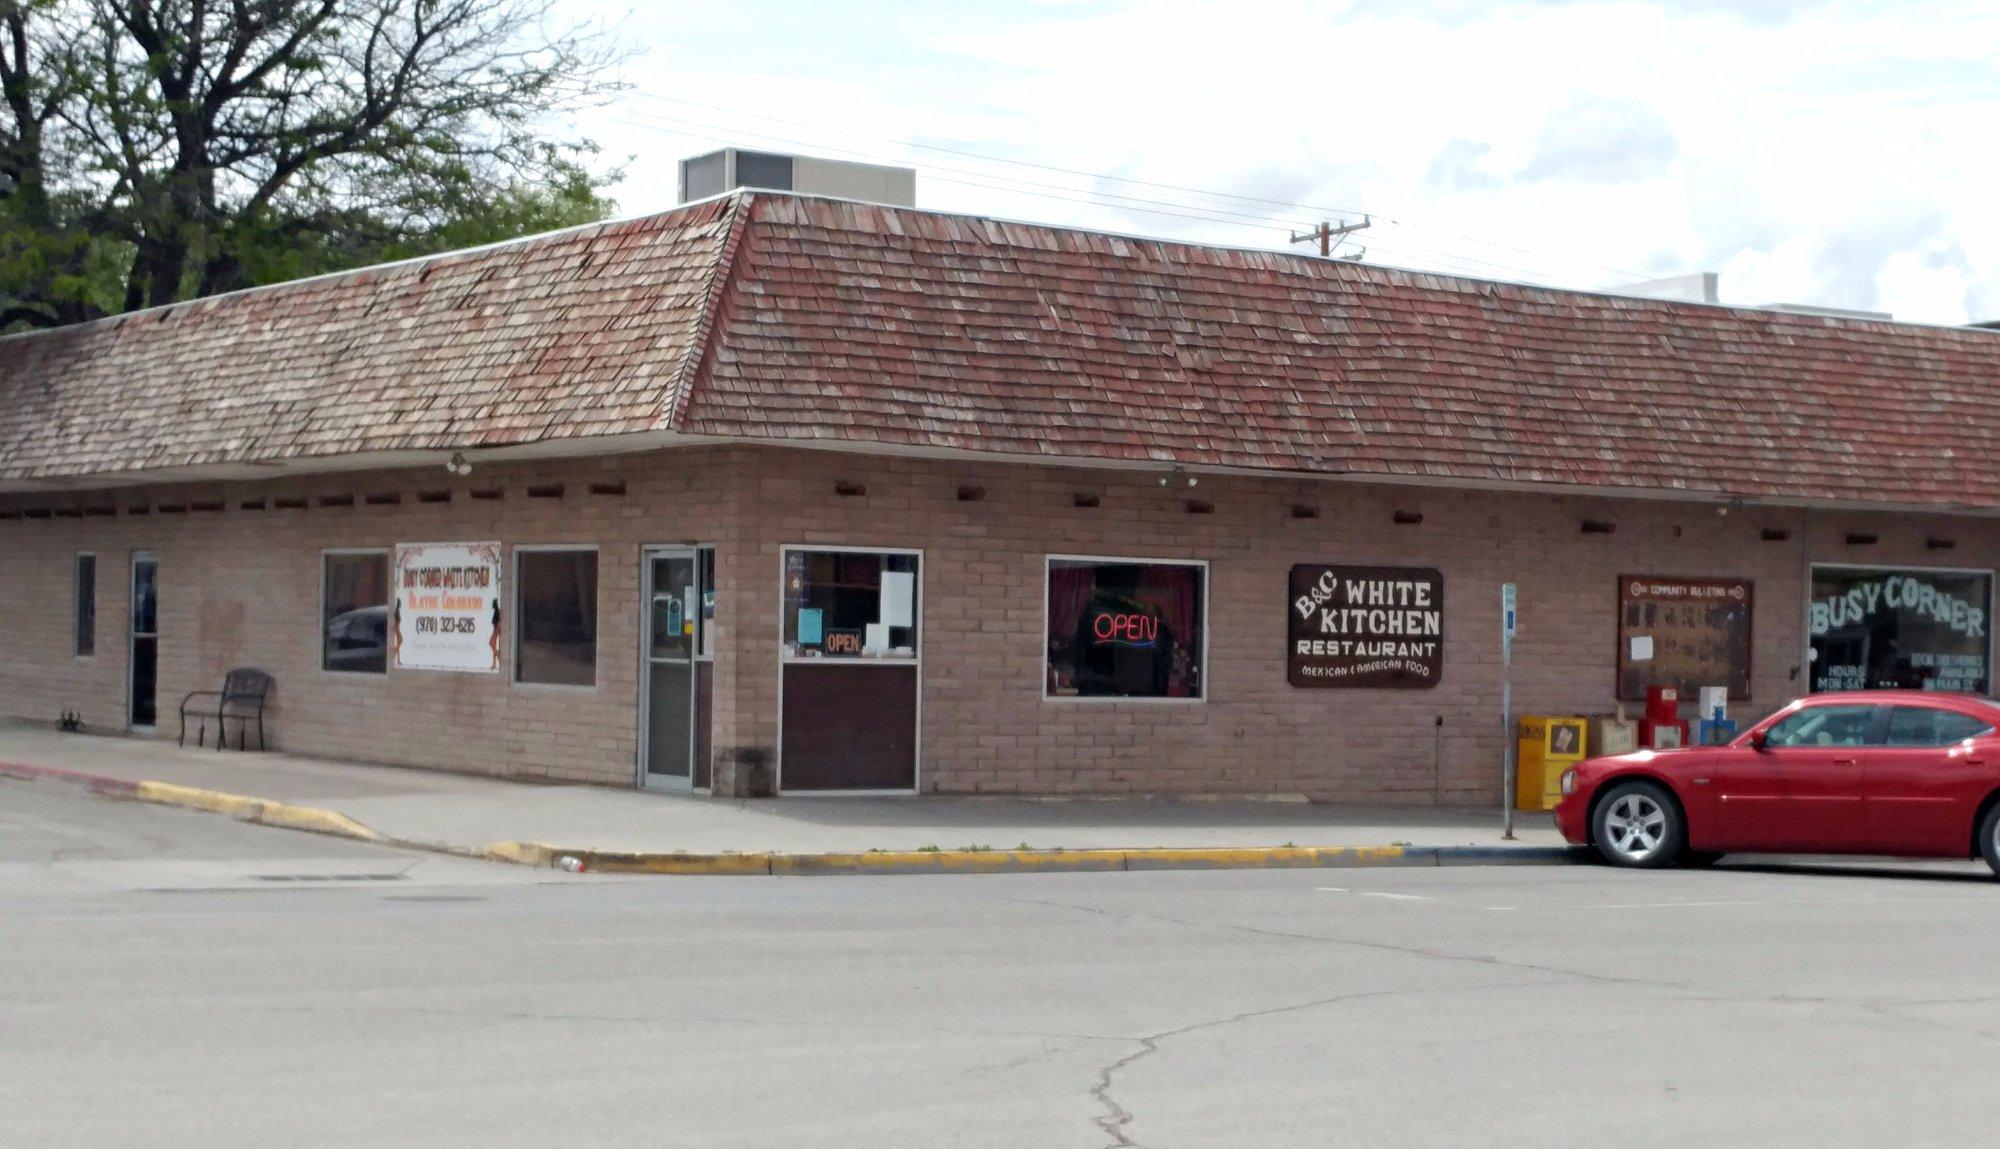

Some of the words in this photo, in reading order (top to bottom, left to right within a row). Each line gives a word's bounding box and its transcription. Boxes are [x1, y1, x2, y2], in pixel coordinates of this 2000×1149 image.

[1345, 579, 1432, 606] WHITE
[1650, 584, 1687, 595] COMMUNITY
[1811, 582, 1881, 635] BUSY
[1884, 576, 1985, 638] CORNER
[416, 616, 438, 634] (970)
[1094, 613, 1158, 640] OPEN
[1320, 608, 1440, 635] KITCHEN
[827, 633, 859, 652] OPEN
[1297, 639, 1436, 657] RESTAURANT
[1302, 664, 1348, 677] MEXICAN
[1357, 660, 1402, 673] AMERICAN
[1405, 660, 1430, 677] FOOD
